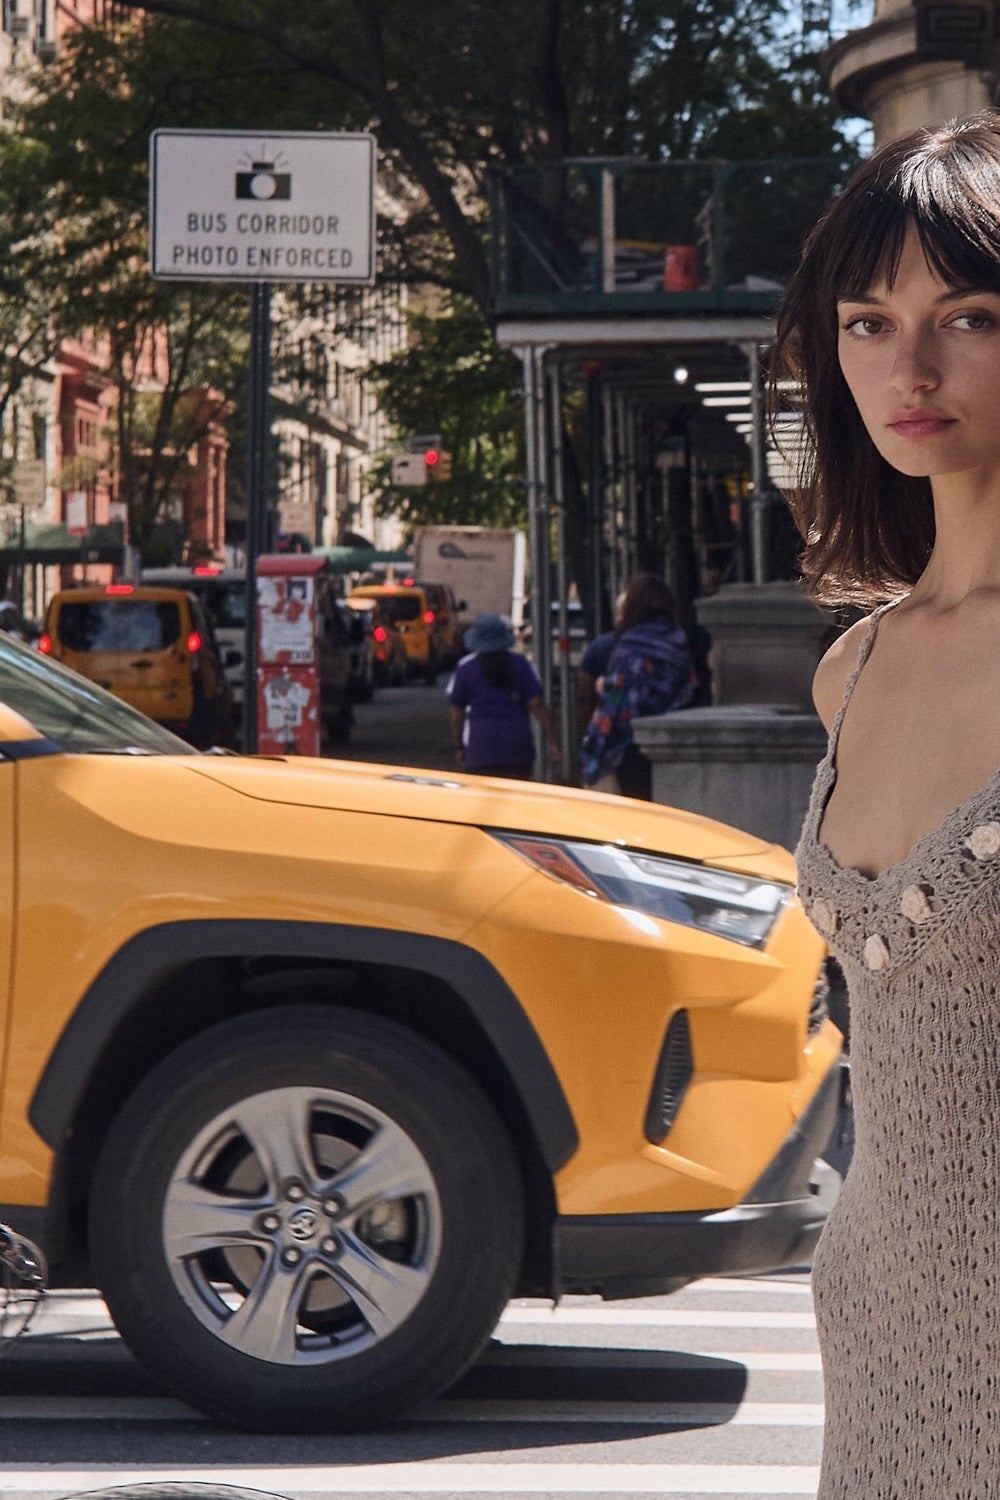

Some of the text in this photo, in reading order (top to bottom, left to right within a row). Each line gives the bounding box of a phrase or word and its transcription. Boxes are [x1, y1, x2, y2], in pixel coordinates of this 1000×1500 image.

[187, 213, 339, 234] BUS CORRIDOR
[173, 245, 353, 268] PHOTO ENFORCED
